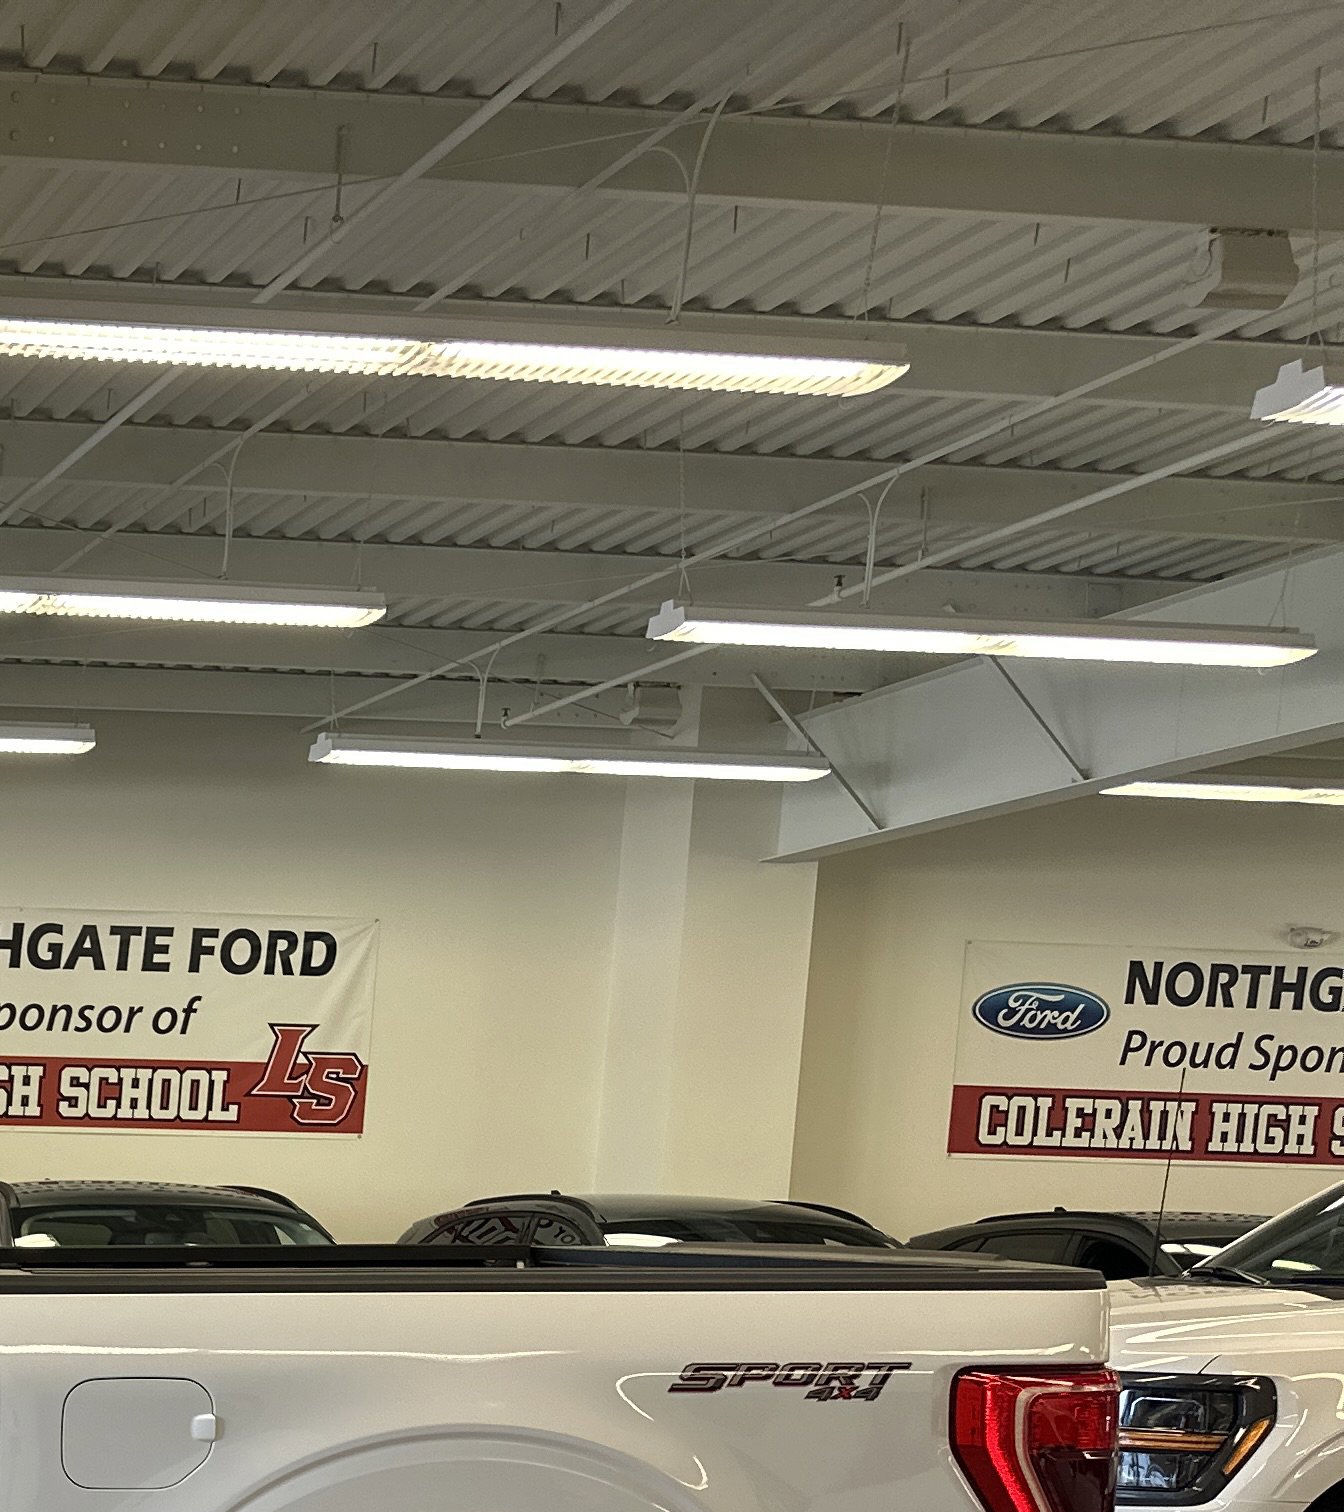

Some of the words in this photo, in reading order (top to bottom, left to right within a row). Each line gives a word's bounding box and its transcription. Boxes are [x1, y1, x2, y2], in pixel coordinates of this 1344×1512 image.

[187, 926, 338, 978] FORD
[997, 990, 1086, 1031] Ford
[1123, 959, 1344, 1014] NORTHG
[151, 994, 203, 1035] of
[244, 1022, 363, 1126] LS
[1118, 1028, 1245, 1071] Proud
[57, 1065, 241, 1123] SCHOOL
[977, 1093, 1197, 1153] COLERAIN
[1206, 1101, 1322, 1157] HIGH
[667, 1361, 913, 1394] SPORT
